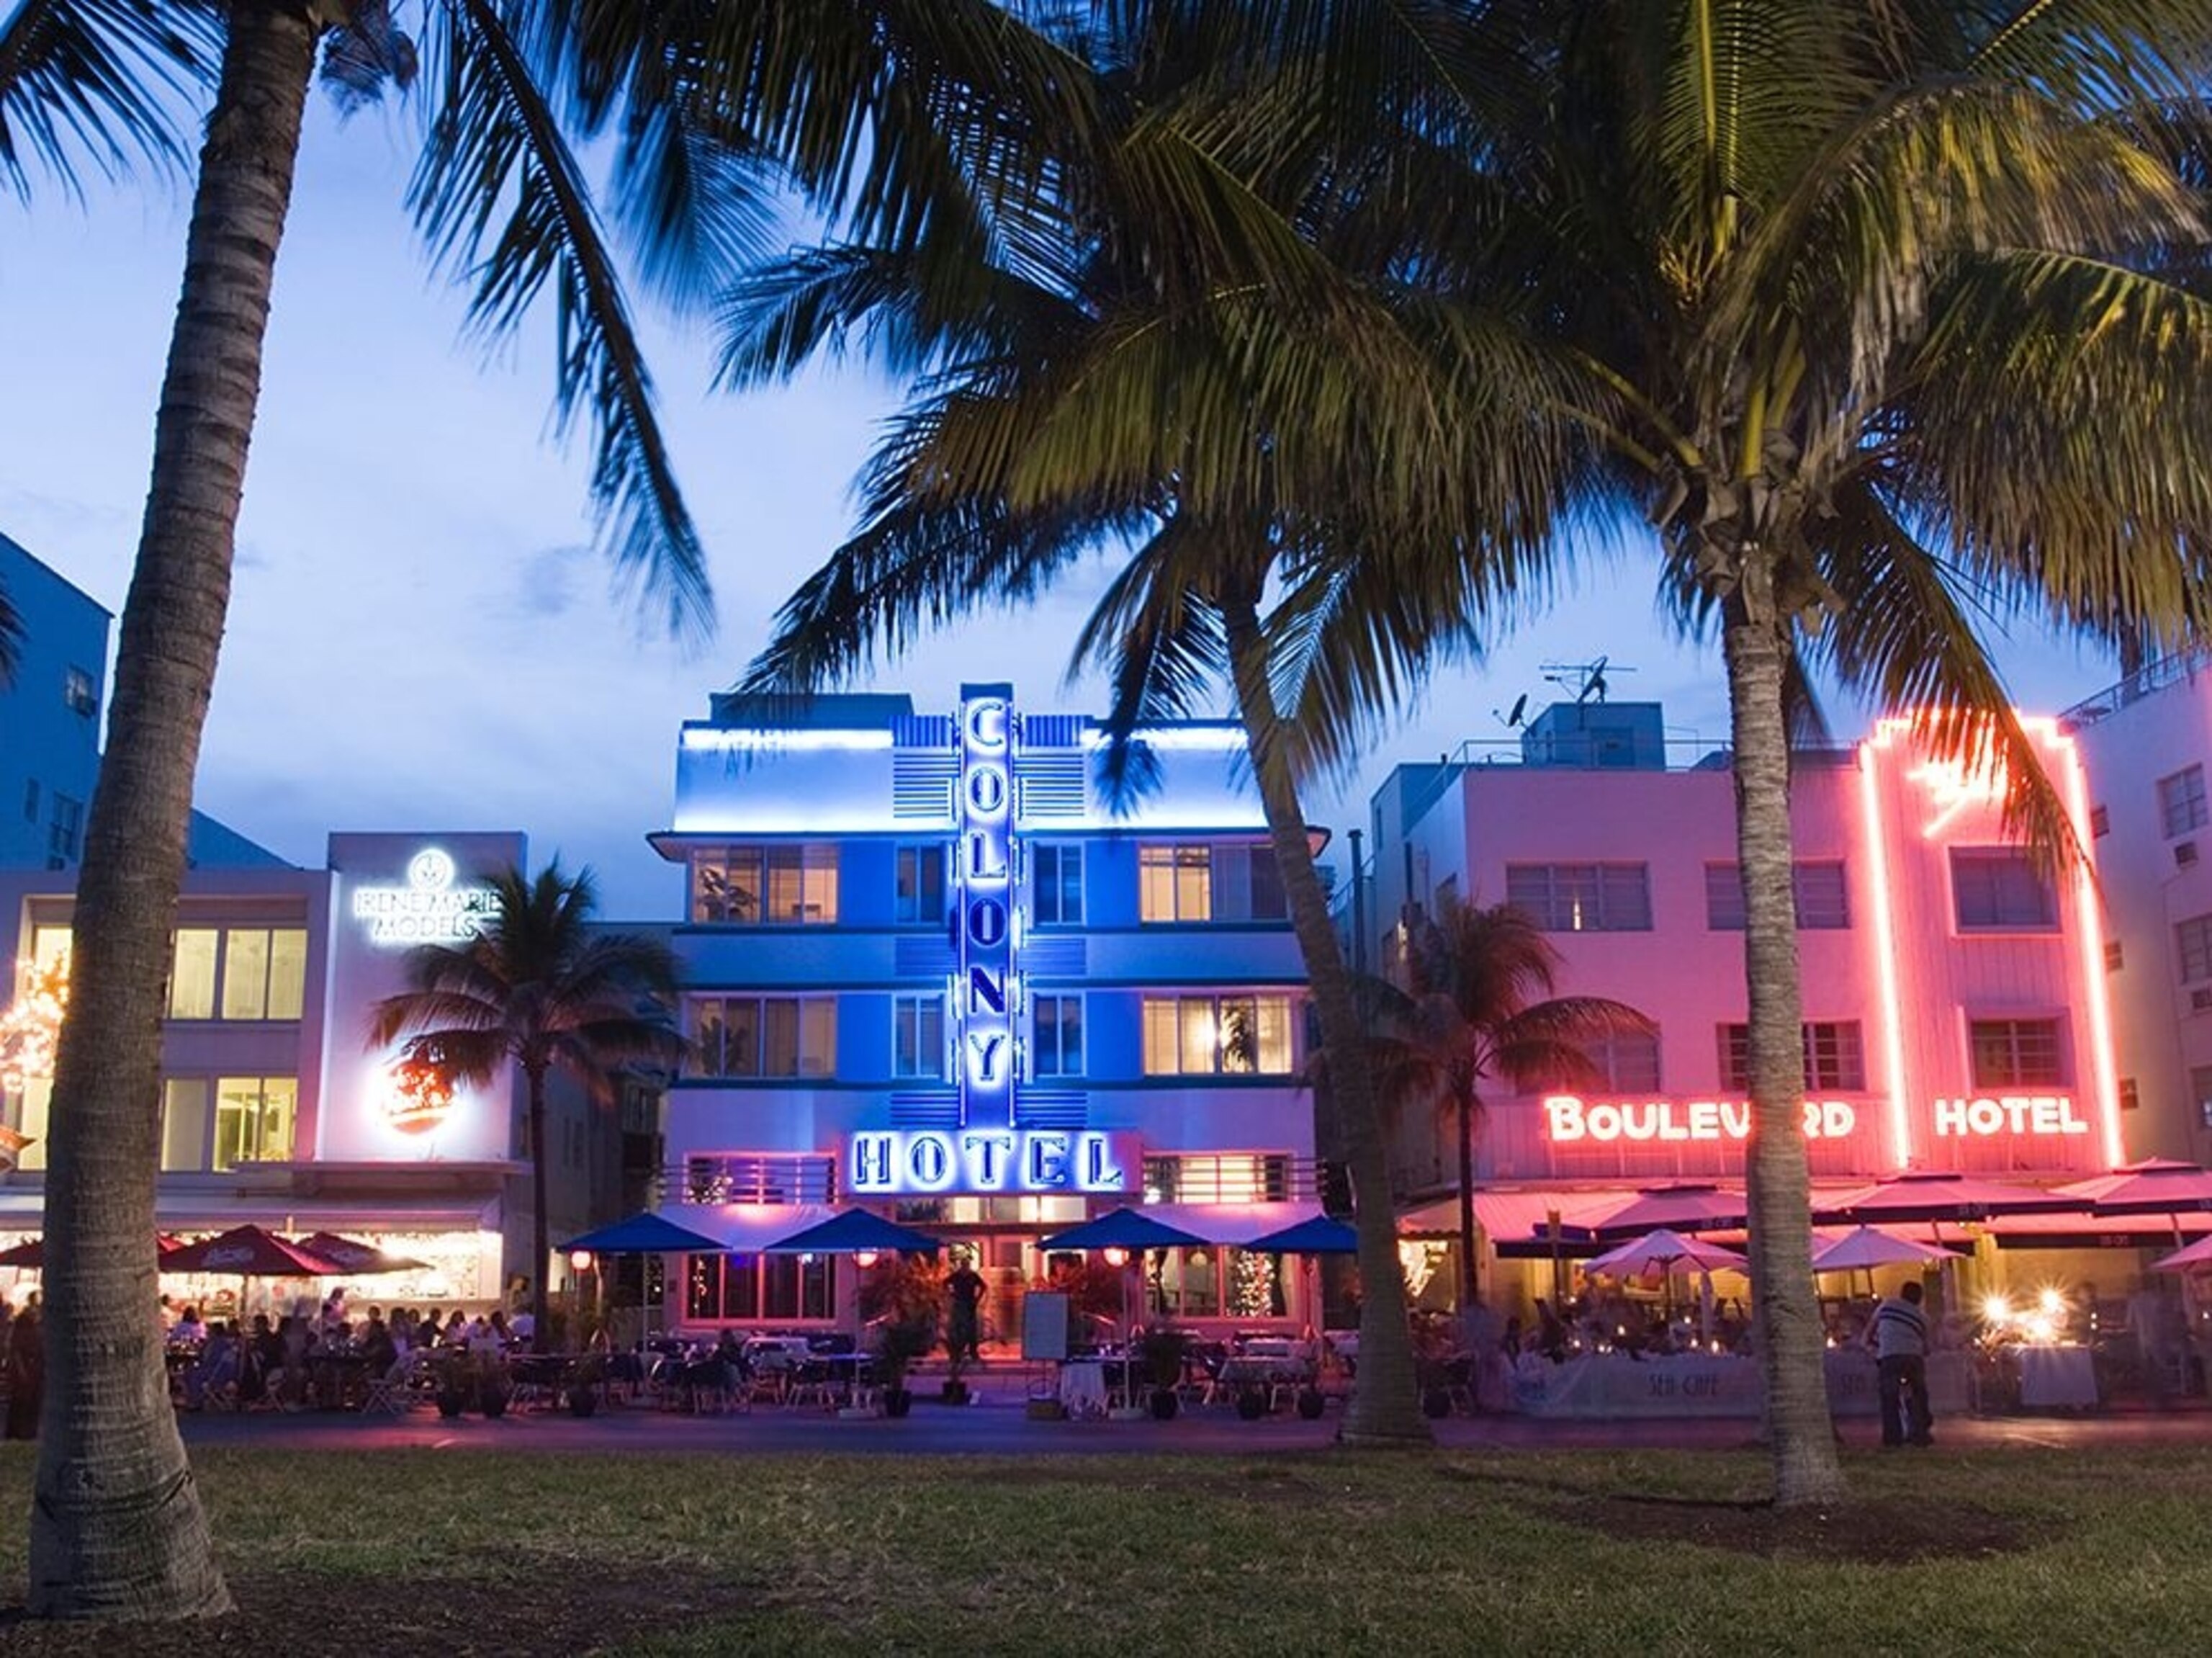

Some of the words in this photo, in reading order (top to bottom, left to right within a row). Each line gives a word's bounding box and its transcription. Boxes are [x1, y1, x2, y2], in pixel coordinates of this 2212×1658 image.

[357, 892, 422, 913] IRENE
[969, 701, 1007, 1081] COLONY
[374, 916, 476, 937] MODELS
[1544, 1096, 1856, 1141] BOULEVRD
[1935, 1096, 2088, 1136] HOTEL
[855, 1137, 1122, 1185] HOTEL
